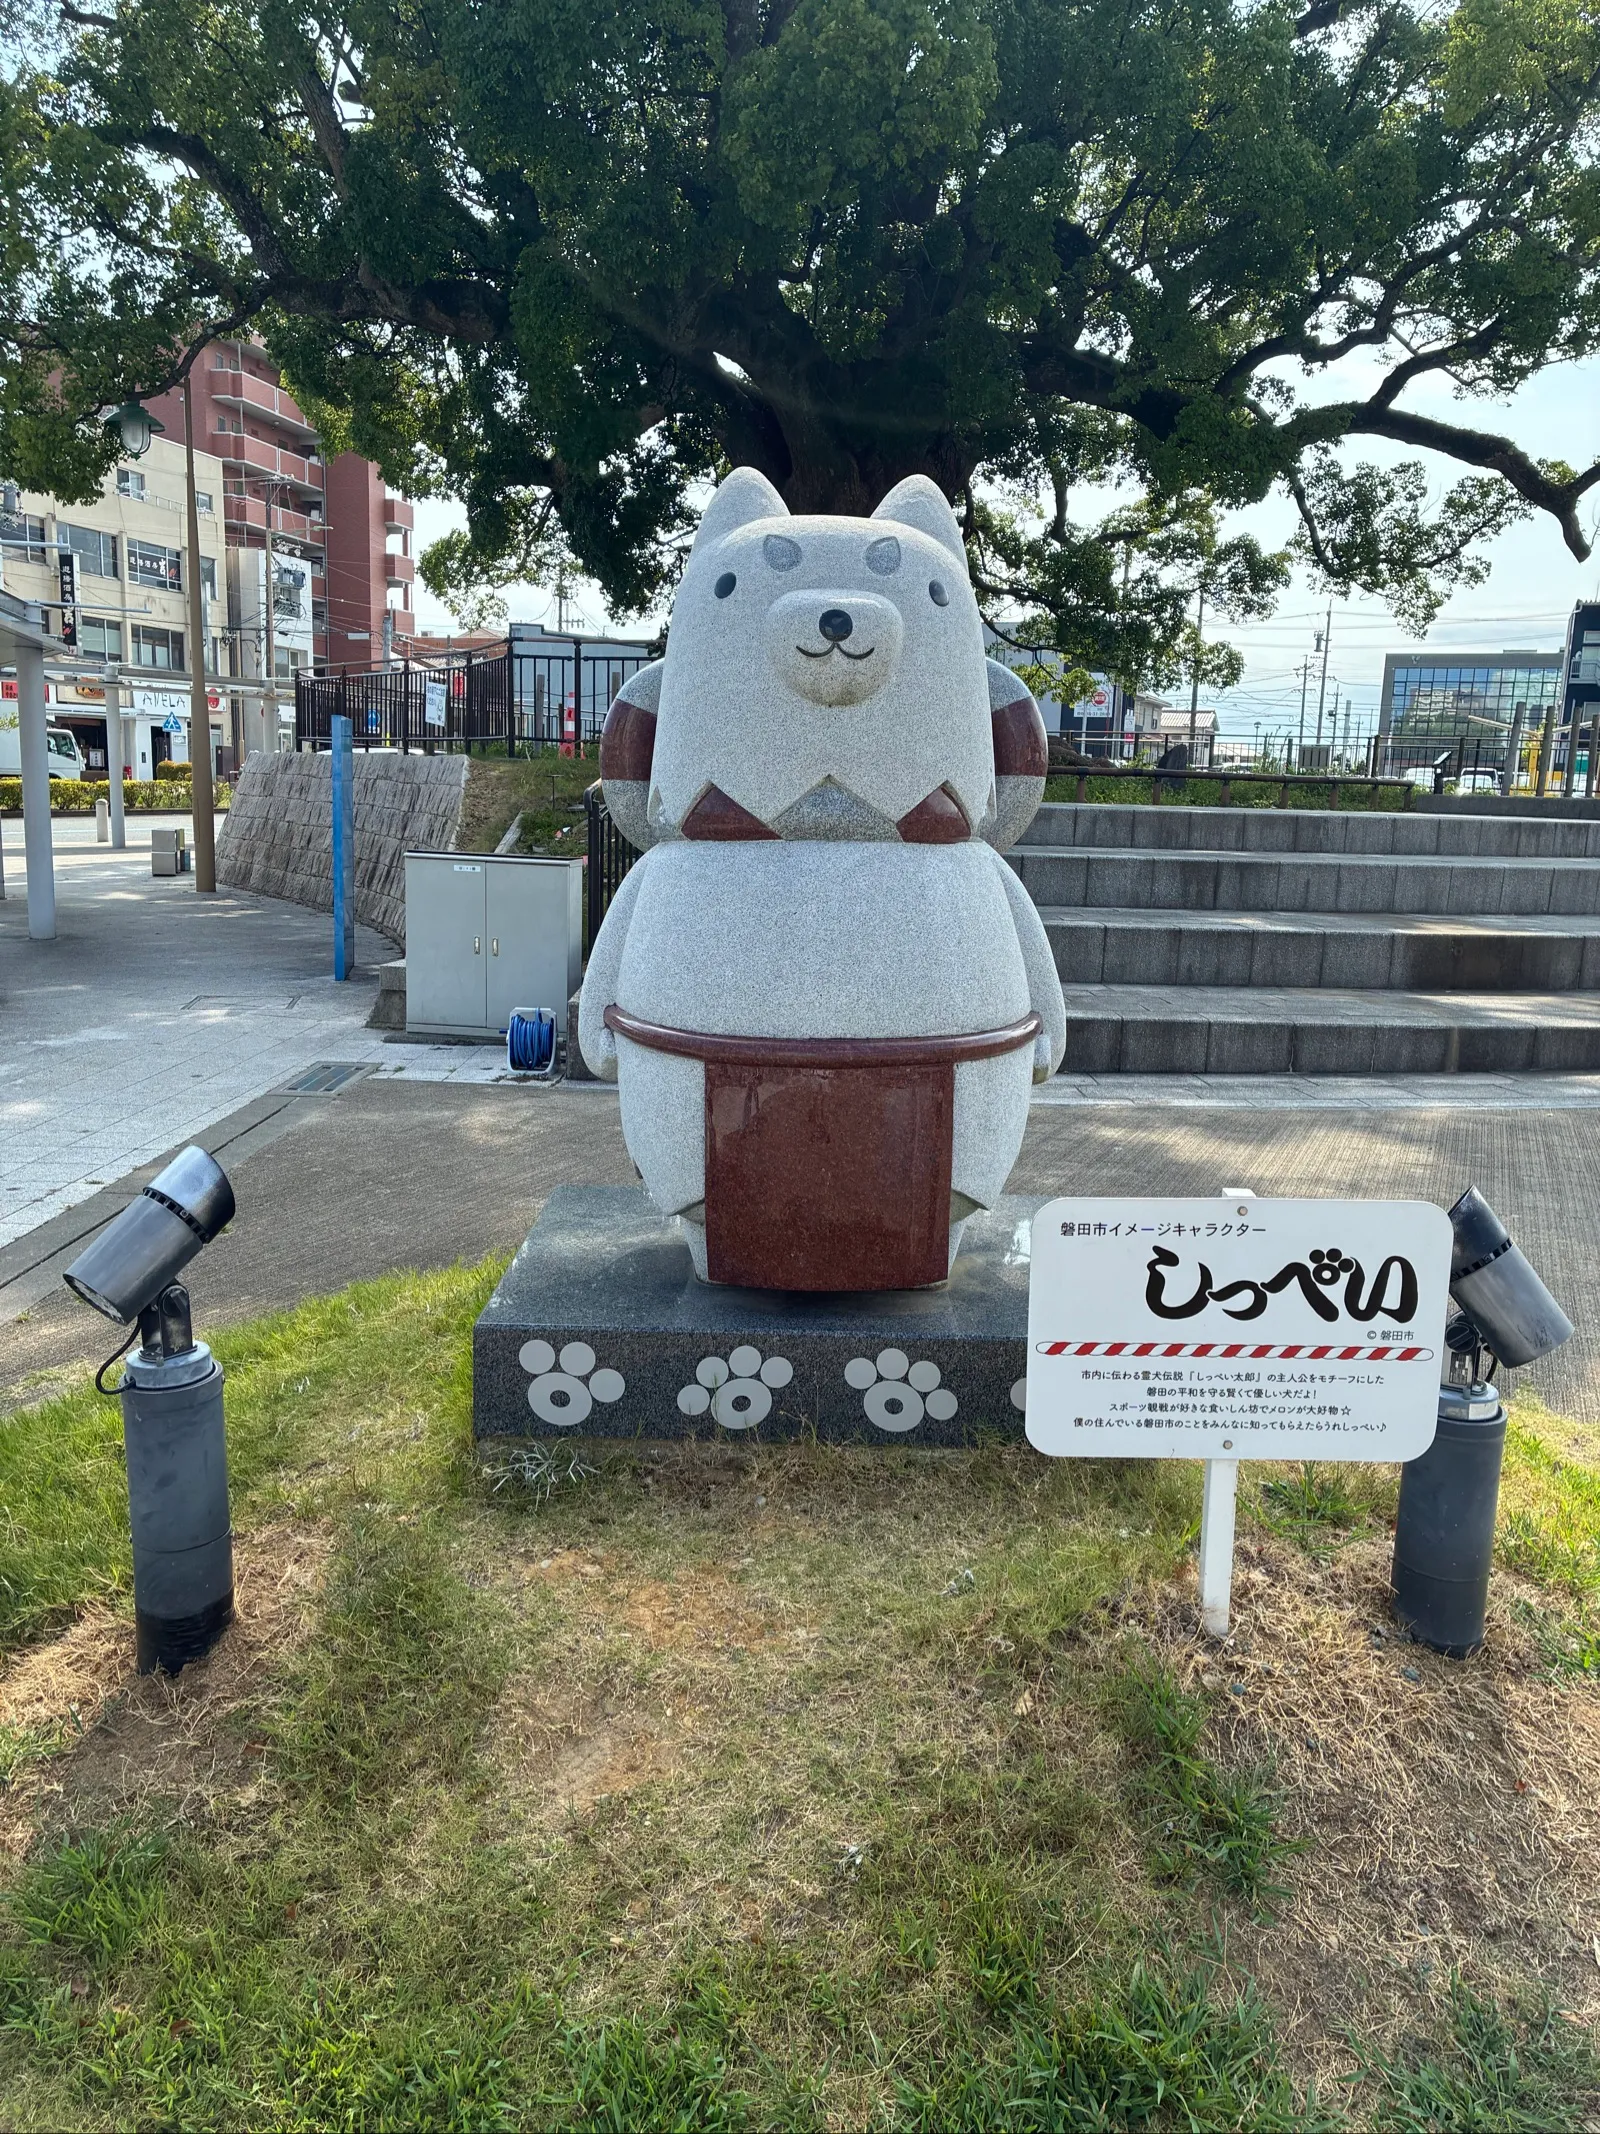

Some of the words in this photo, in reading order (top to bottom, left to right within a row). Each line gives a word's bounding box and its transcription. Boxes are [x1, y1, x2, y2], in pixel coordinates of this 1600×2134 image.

[1060, 1222, 1267, 1237] 磐田市イメージキャラクター
[1145, 1245, 1419, 1324] しっぺい
[1380, 1329, 1415, 1342] 磐田市
